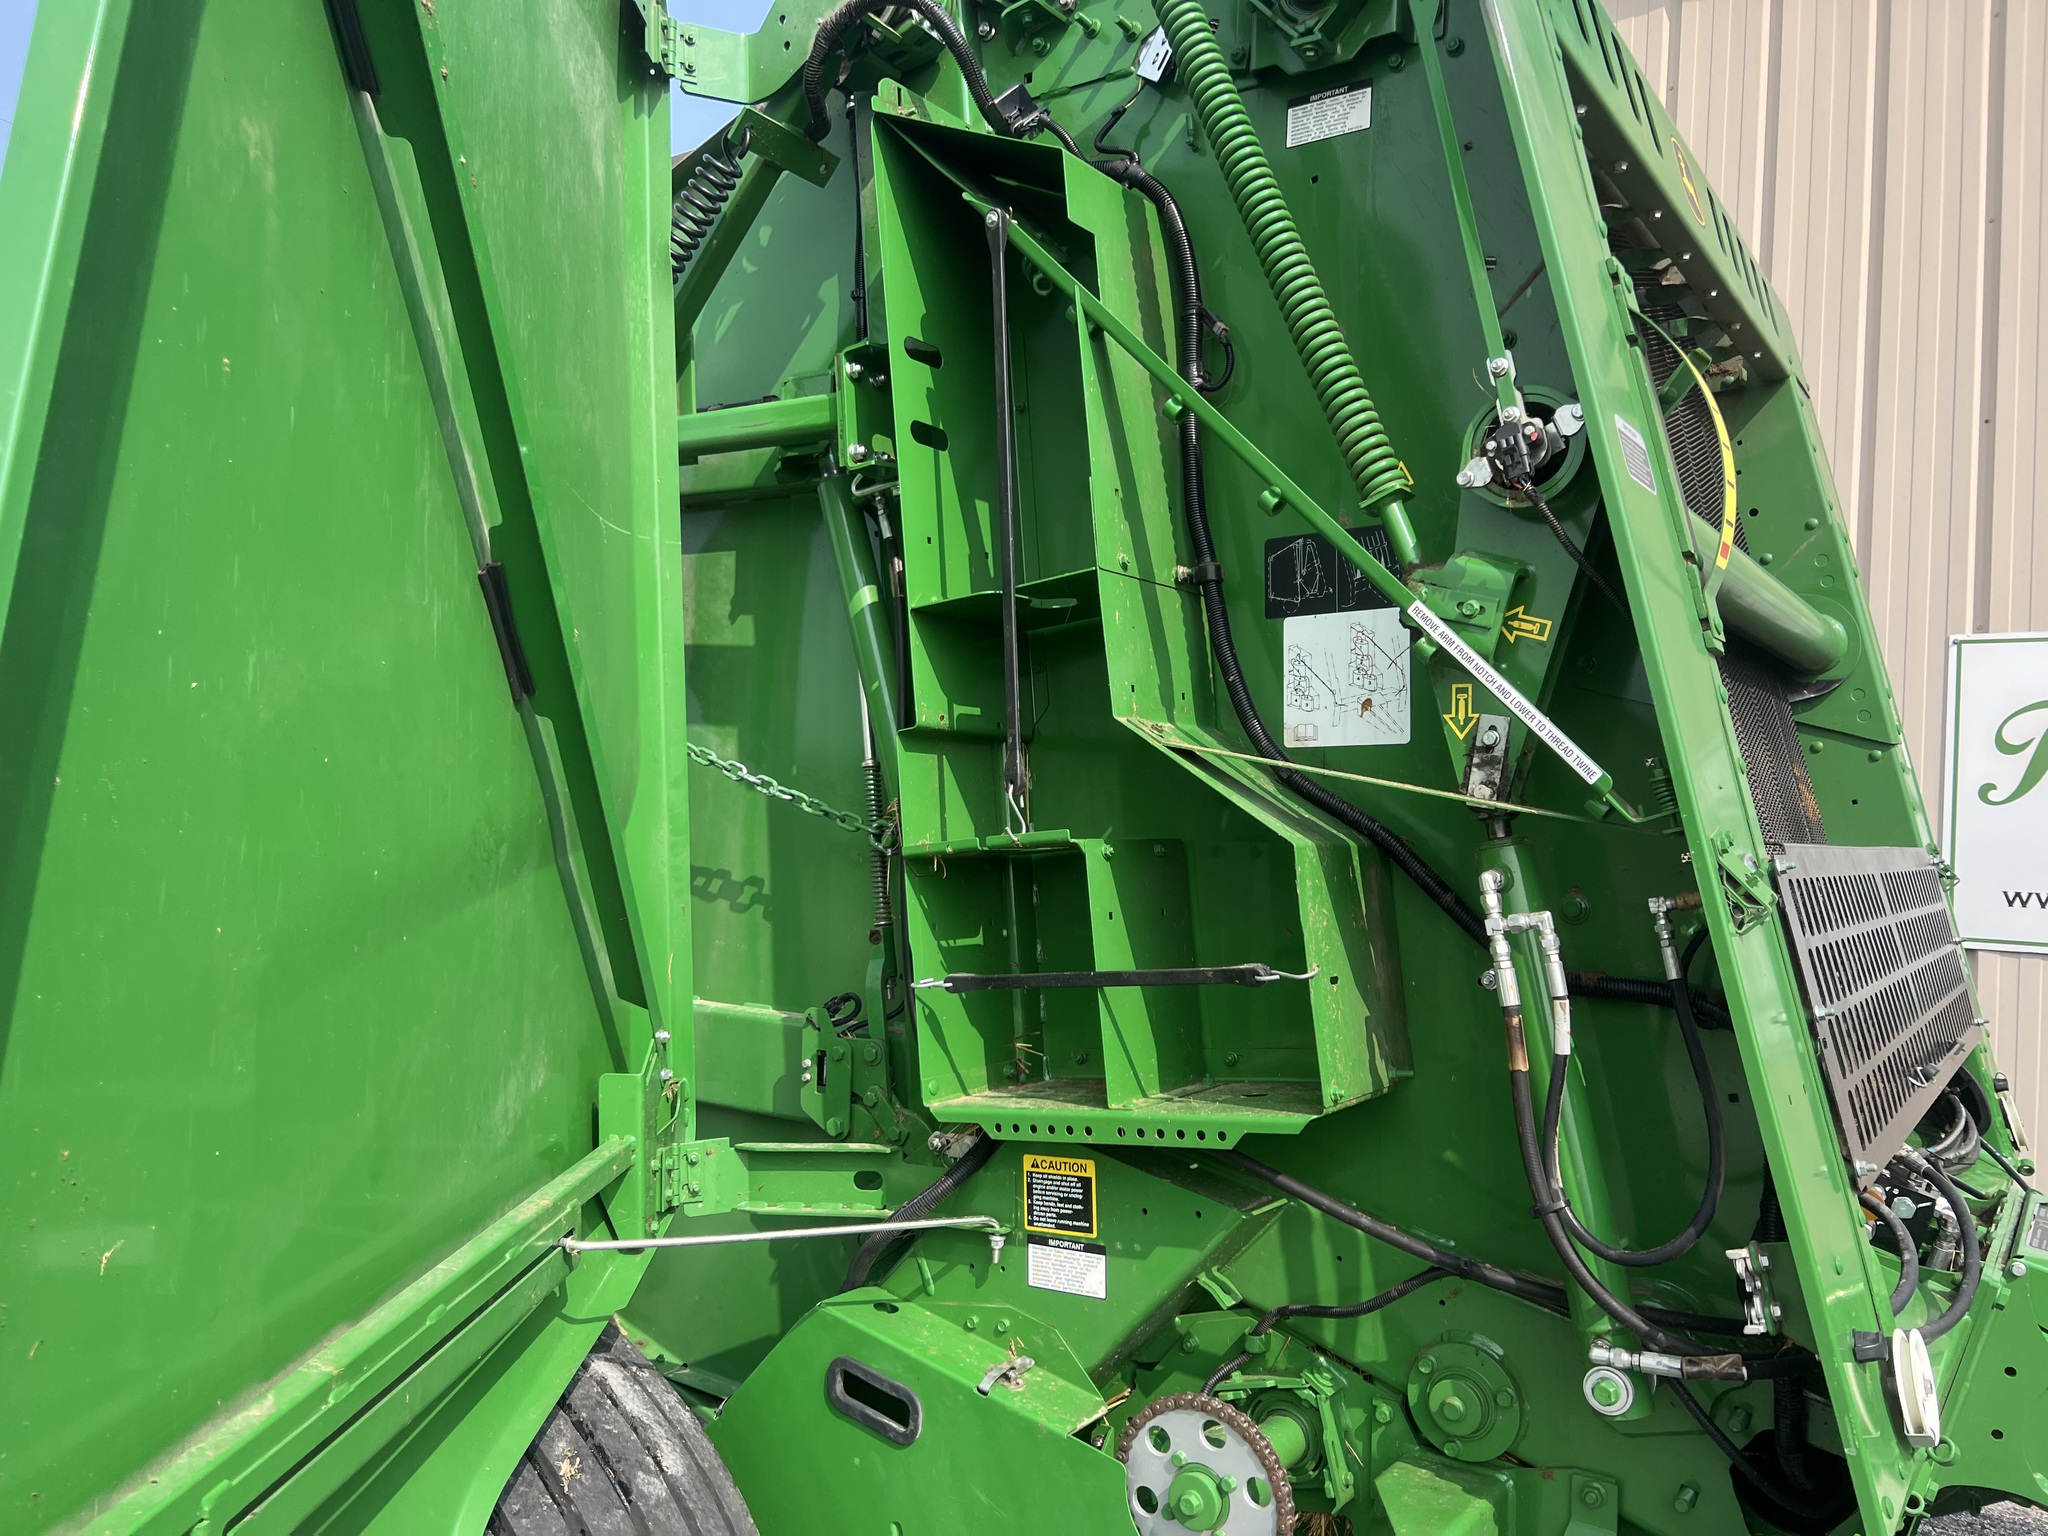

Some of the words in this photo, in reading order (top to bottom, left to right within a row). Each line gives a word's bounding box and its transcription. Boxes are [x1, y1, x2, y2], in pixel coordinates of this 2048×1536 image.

[1310, 87, 1349, 101] IMPORTANT
[1412, 605, 1440, 636] REMOVE
[1438, 629, 1456, 648] ARM
[1453, 644, 1474, 666] FROM
[1472, 662, 1498, 686] NOTCH
[1495, 683, 1515, 700] AND
[1510, 696, 1536, 723] LOWER
[1535, 719, 1547, 733] TO
[1544, 730, 1573, 758] THREAD
[1572, 755, 1598, 781] TWINE
[1040, 1160, 1087, 1173] CAUTION
[1049, 1239, 1084, 1250] IMPORTANT
